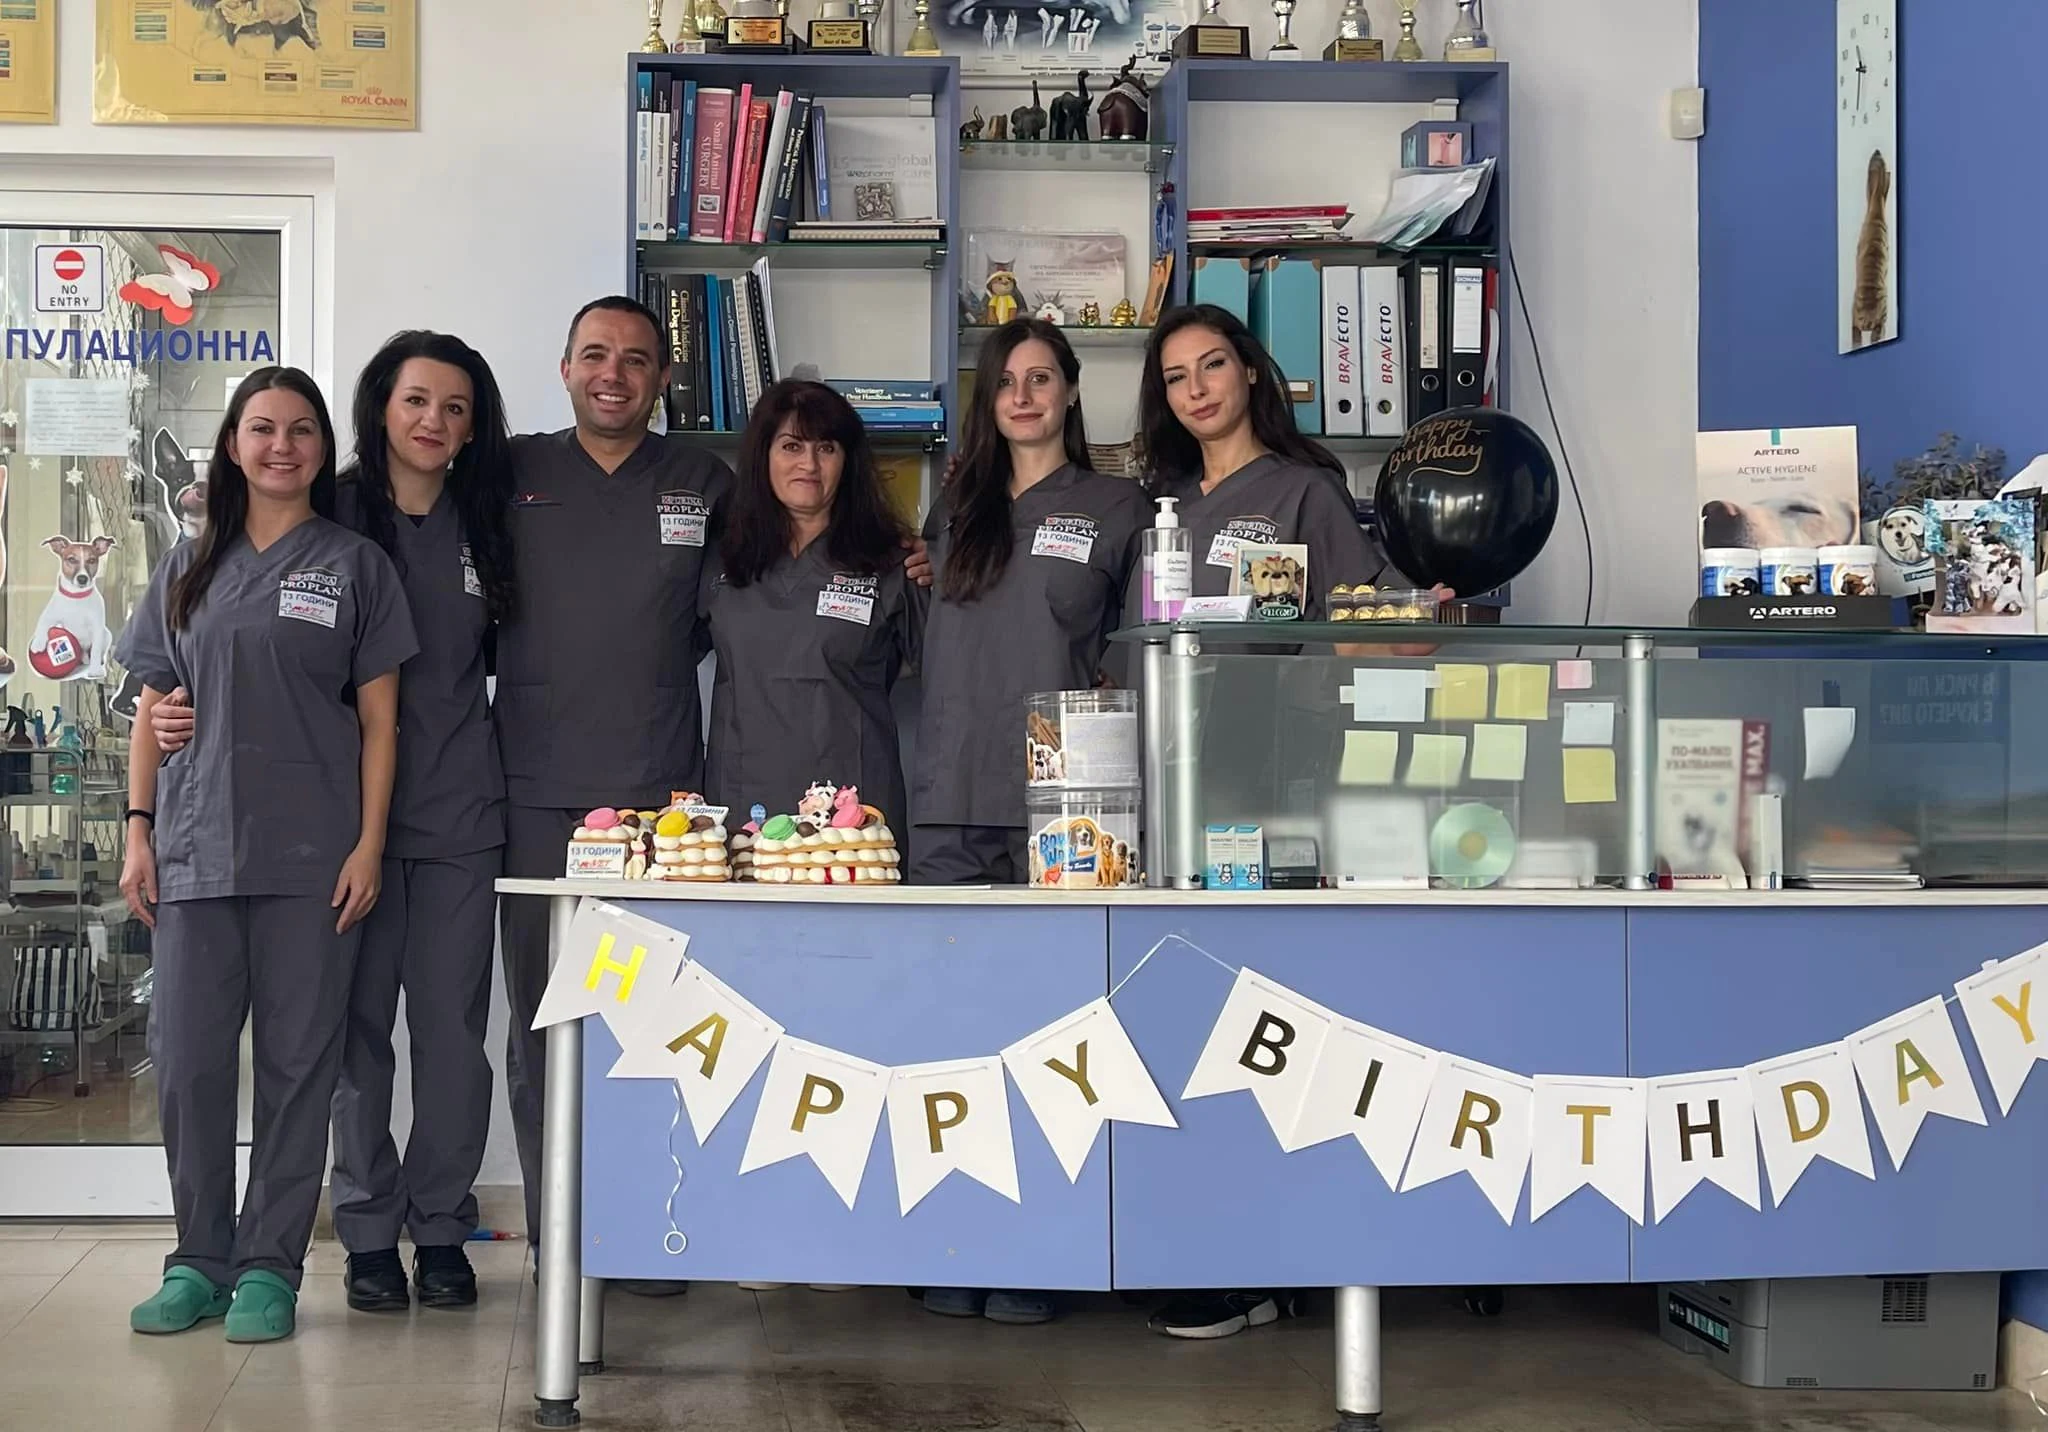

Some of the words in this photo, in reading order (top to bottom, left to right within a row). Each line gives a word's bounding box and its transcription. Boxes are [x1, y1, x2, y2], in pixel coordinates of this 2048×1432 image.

[341, 96, 373, 105] ROYAL
[375, 96, 408, 108] CANIN
[712, 122, 723, 150] Small
[699, 136, 712, 189] SURGERY
[711, 153, 723, 190] Animal
[62, 284, 78, 295] NO
[50, 297, 89, 307] ENTRY
[680, 290, 690, 323] Clinical
[668, 309, 680, 328] Dog
[672, 330, 680, 346] and
[682, 324, 691, 363] Medicine
[1334, 304, 1353, 384] BRAVECTO
[1376, 304, 1396, 385] BRAVECTO
[6, 329, 275, 368] ПУЛАЦИОННА
[1404, 418, 1478, 446] Happy
[1388, 436, 1483, 477] Birthday
[1754, 448, 1800, 457] ARTERO
[1737, 466, 1772, 475] ACTIVE
[1774, 465, 1817, 474] HYGIENE
[674, 518, 704, 526] ГОДИНИ
[1050, 534, 1089, 546] ГОДИНИ
[296, 594, 334, 609] ГОДИНИ
[834, 594, 870, 606] ГОДИНИ
[1769, 606, 1836, 616] ARTERO
[572, 848, 581, 856] 13
[584, 847, 622, 856] ГОДИНИ
